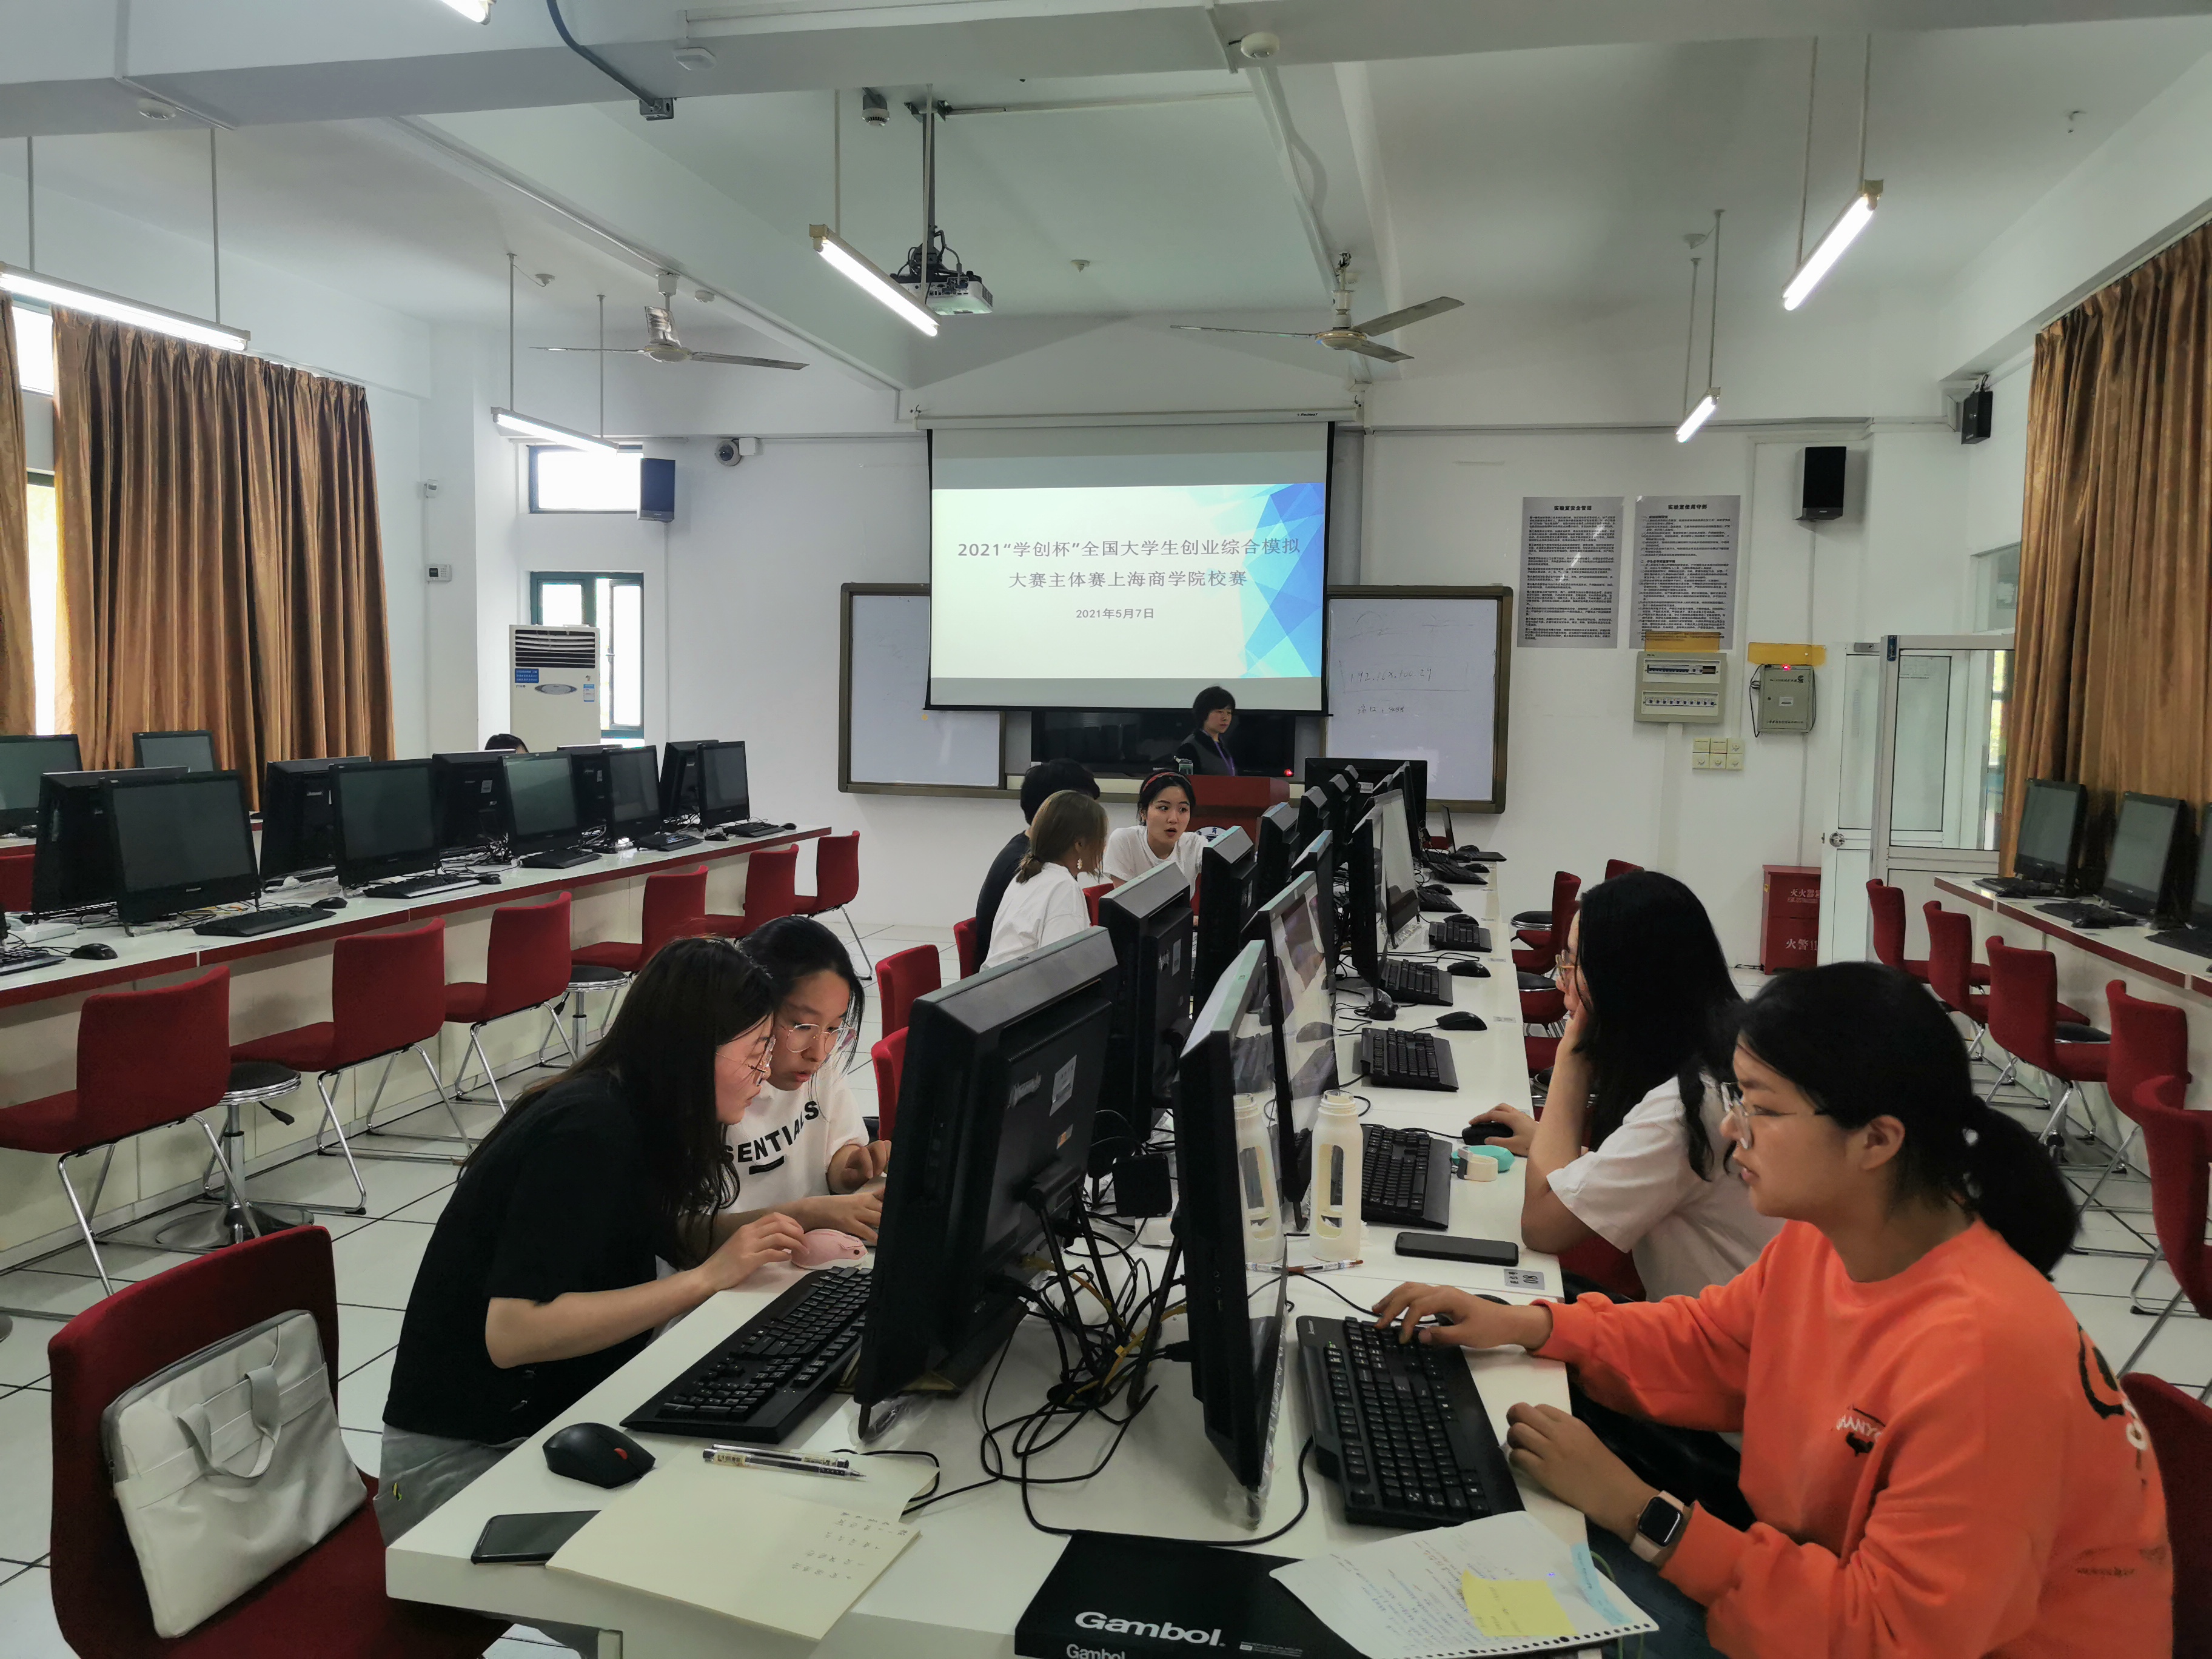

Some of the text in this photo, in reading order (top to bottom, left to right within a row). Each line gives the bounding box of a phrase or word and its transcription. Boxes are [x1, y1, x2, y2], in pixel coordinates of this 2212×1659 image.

[1008, 569, 1247, 588] 大赛主体赛上海商学院校赛
[1076, 608, 1155, 620] 2021年5月7日
[1074, 1611, 1222, 1646] Gambol
